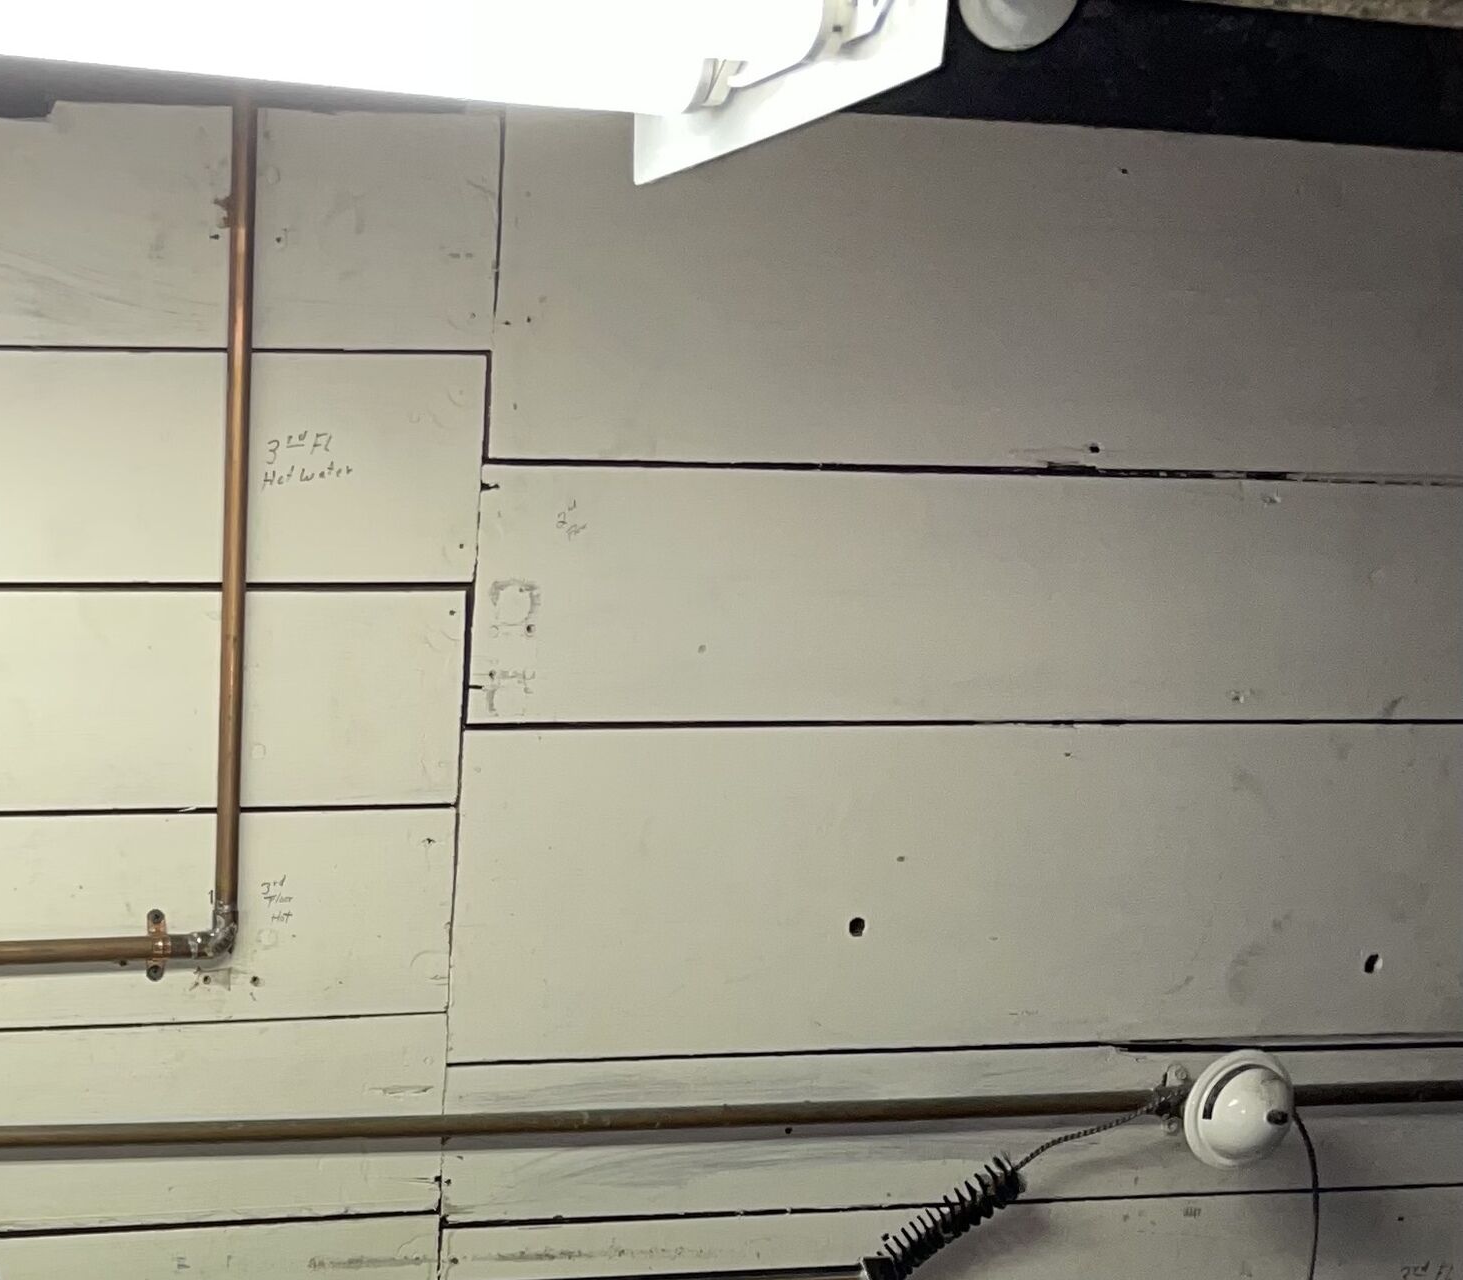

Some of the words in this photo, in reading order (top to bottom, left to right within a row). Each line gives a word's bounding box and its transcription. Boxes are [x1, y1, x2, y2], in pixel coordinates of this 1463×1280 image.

[266, 430, 308, 465] 3rd
[261, 465, 295, 492] Hot
[260, 874, 287, 895] 3rd
